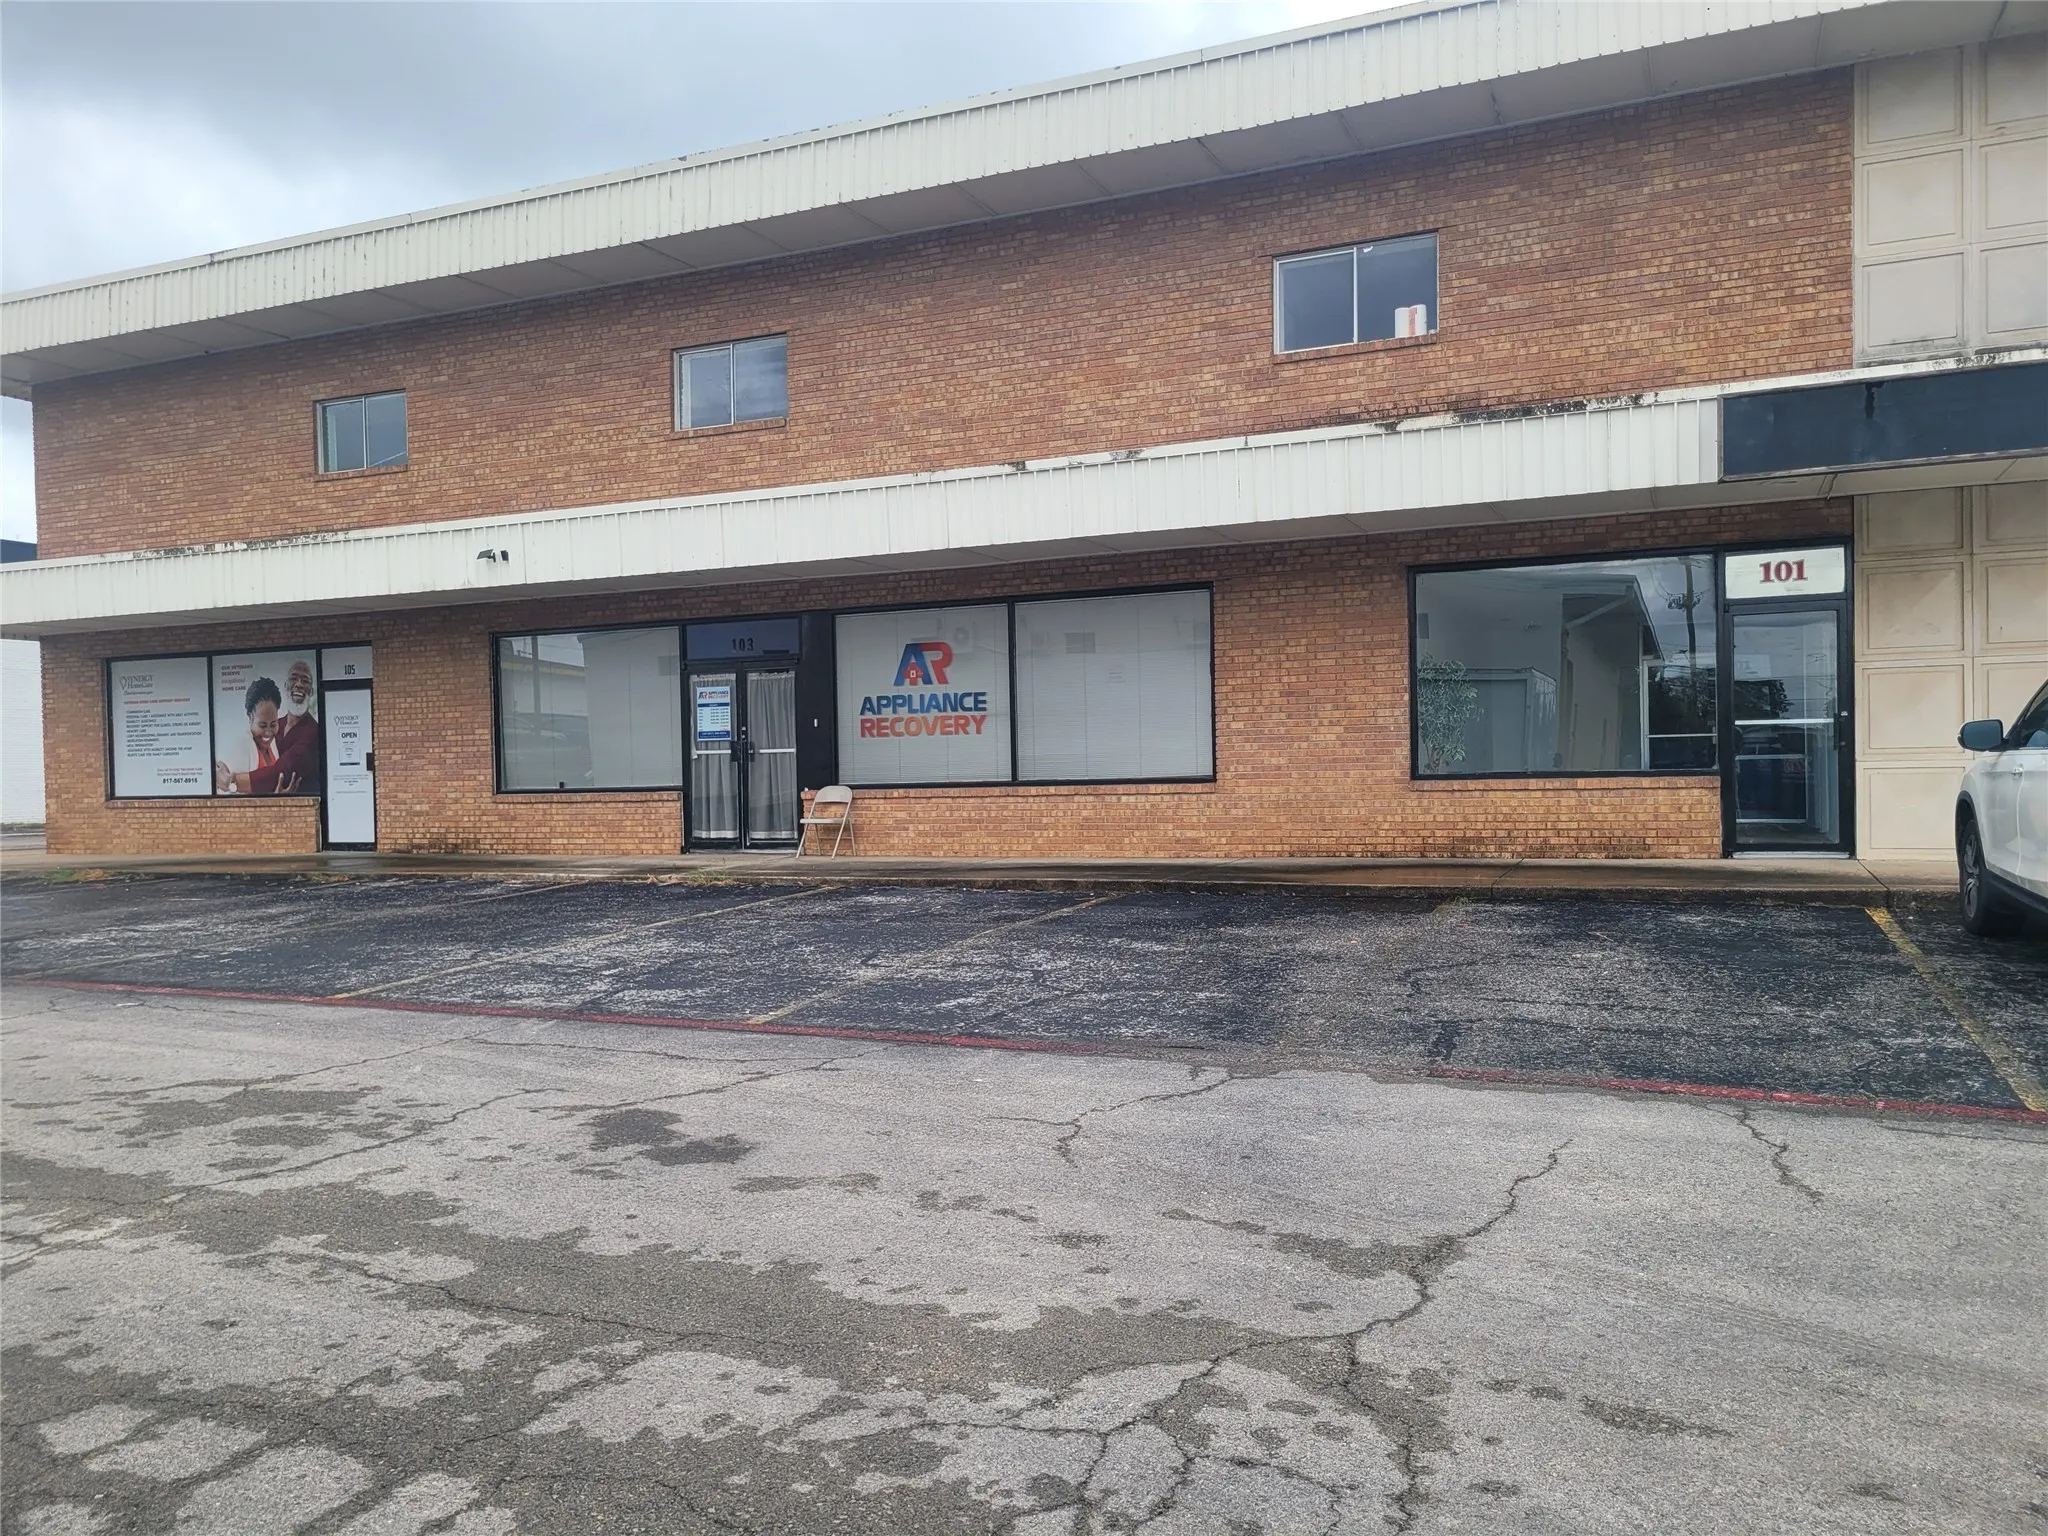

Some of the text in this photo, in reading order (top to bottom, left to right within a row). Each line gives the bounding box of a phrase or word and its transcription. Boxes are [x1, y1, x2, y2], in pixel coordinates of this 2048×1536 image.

[1760, 560, 1808, 584] 101
[732, 638, 754, 652] 103
[344, 664, 356, 675] 105
[860, 692, 987, 716] APPLIANCE
[860, 715, 987, 738] RECOVERY
